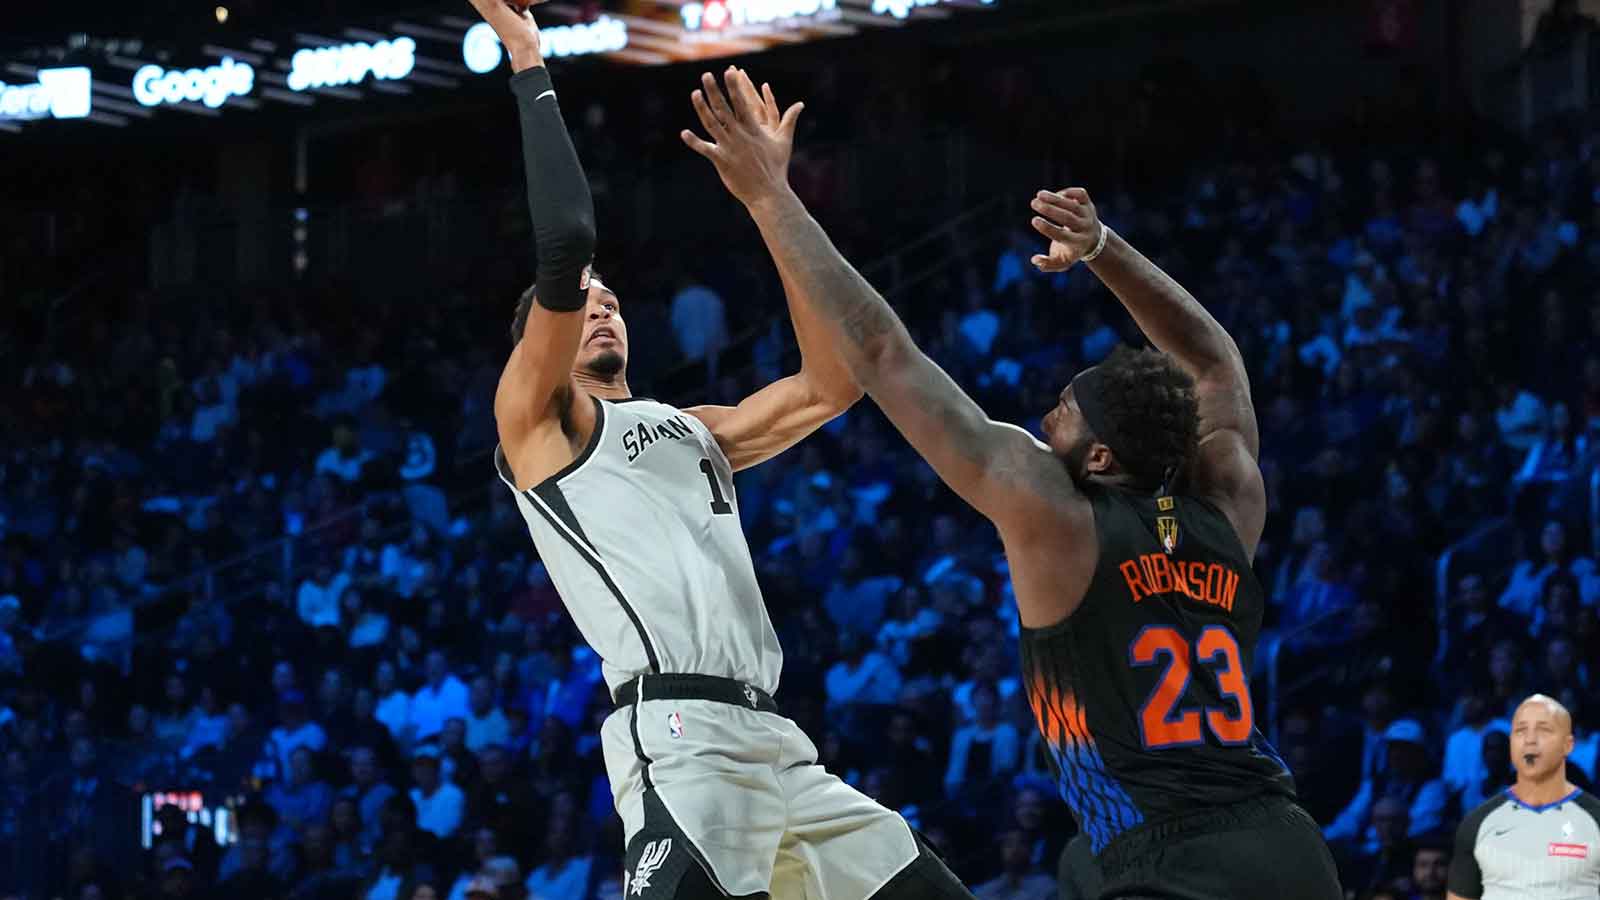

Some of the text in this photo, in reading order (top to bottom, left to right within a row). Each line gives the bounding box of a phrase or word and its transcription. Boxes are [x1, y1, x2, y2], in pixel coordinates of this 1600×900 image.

[132, 56, 254, 108] Google
[699, 458, 733, 515] 1
[1120, 553, 1240, 613] ROBNSON
[1130, 625, 1254, 750] 23
